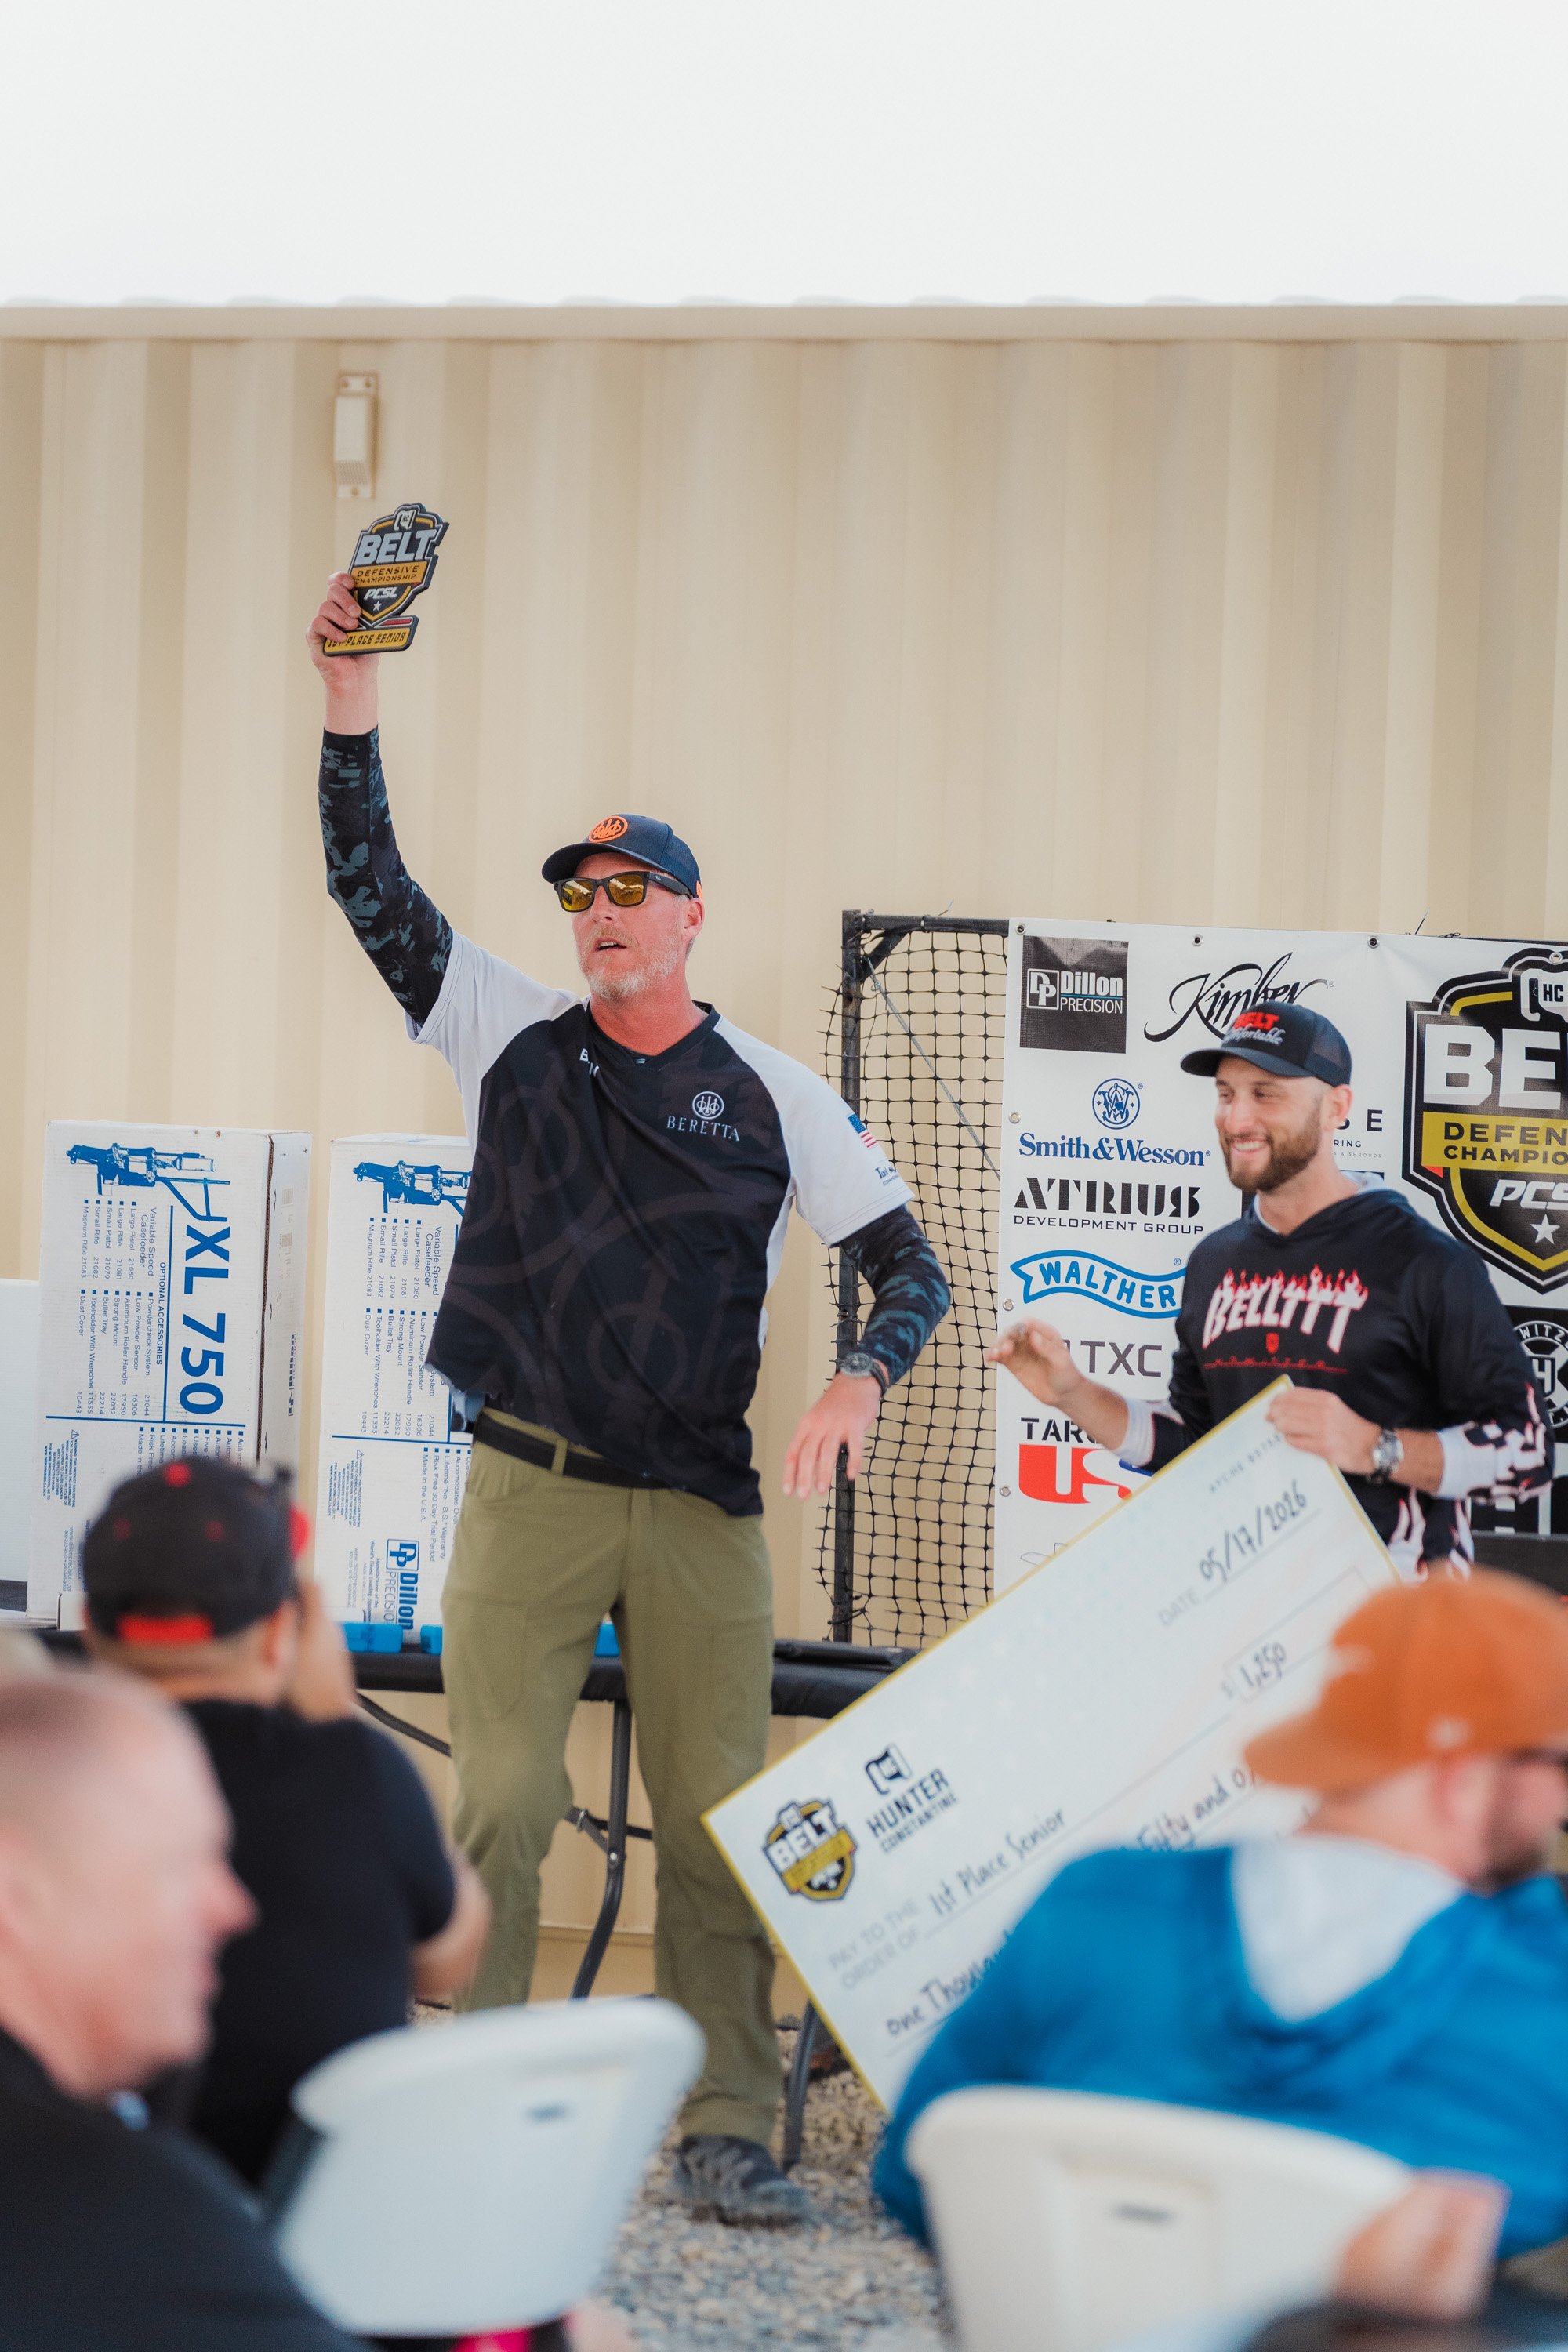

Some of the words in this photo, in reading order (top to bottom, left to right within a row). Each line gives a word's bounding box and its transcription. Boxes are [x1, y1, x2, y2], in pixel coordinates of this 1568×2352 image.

[354, 529, 437, 565] BELT
[354, 574, 416, 585] CHAMPIONSHIP
[357, 565, 419, 577] DEFENSIVE
[364, 586, 397, 601] PCSL
[345, 634, 374, 646] PLACE
[375, 632, 406, 644] SENIOR
[1061, 971, 1123, 996] Dillon
[1144, 952, 1328, 1042] Kimber
[1543, 984, 1563, 1002] HC
[1060, 997, 1123, 1014] PRECISION
[1424, 1024, 1562, 1110] BE
[666, 1115, 740, 1142] BERETTA
[1443, 1121, 1568, 1148] DEFEN
[1443, 1145, 1568, 1167] CHAMPIO
[1014, 1177, 1201, 1218] ATRIUS
[1490, 1179, 1568, 1211] PCS
[1014, 1215, 1137, 1232] DEVELOPMENT
[1144, 1223, 1204, 1234] GROUP
[147, 1247, 156, 1276] Speed
[183, 1225, 230, 1294] XL
[432, 1265, 441, 1295] Speed
[1039, 1261, 1176, 1309] WALTHER
[179, 1312, 226, 1414] 750
[433, 1491, 438, 1501] 30
[1200, 1479, 1306, 1584] 05/17/2026
[383, 1571, 397, 1623] PRECISIO
[398, 1573, 418, 1630] Dillon
[866, 1769, 949, 1838] HUNTER
[766, 1805, 837, 1871] BELT
[956, 1853, 1010, 1897] Place
[1006, 1809, 1065, 1860] Senior
